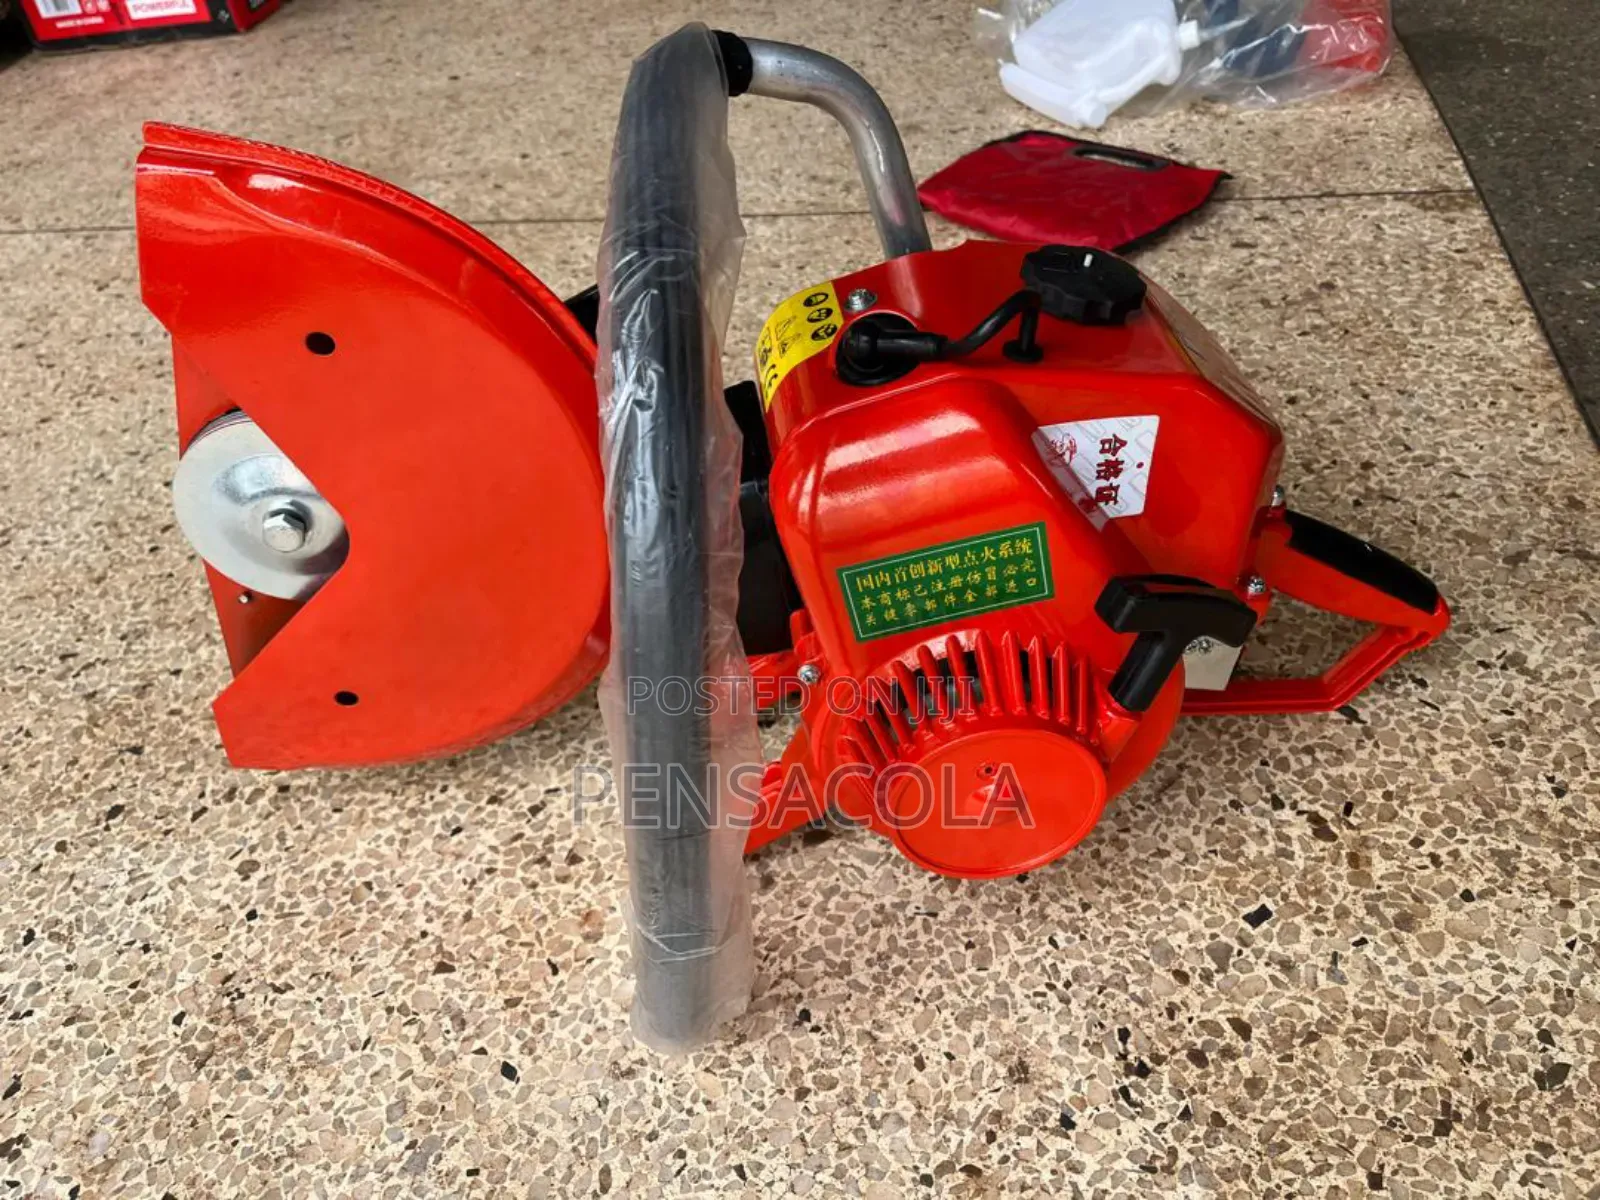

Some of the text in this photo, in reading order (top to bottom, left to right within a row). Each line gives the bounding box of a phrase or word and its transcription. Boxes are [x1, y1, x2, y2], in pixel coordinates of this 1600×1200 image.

[1095, 433, 1127, 506] 合格证
[855, 537, 1033, 593] 国内首创新型点火系统
